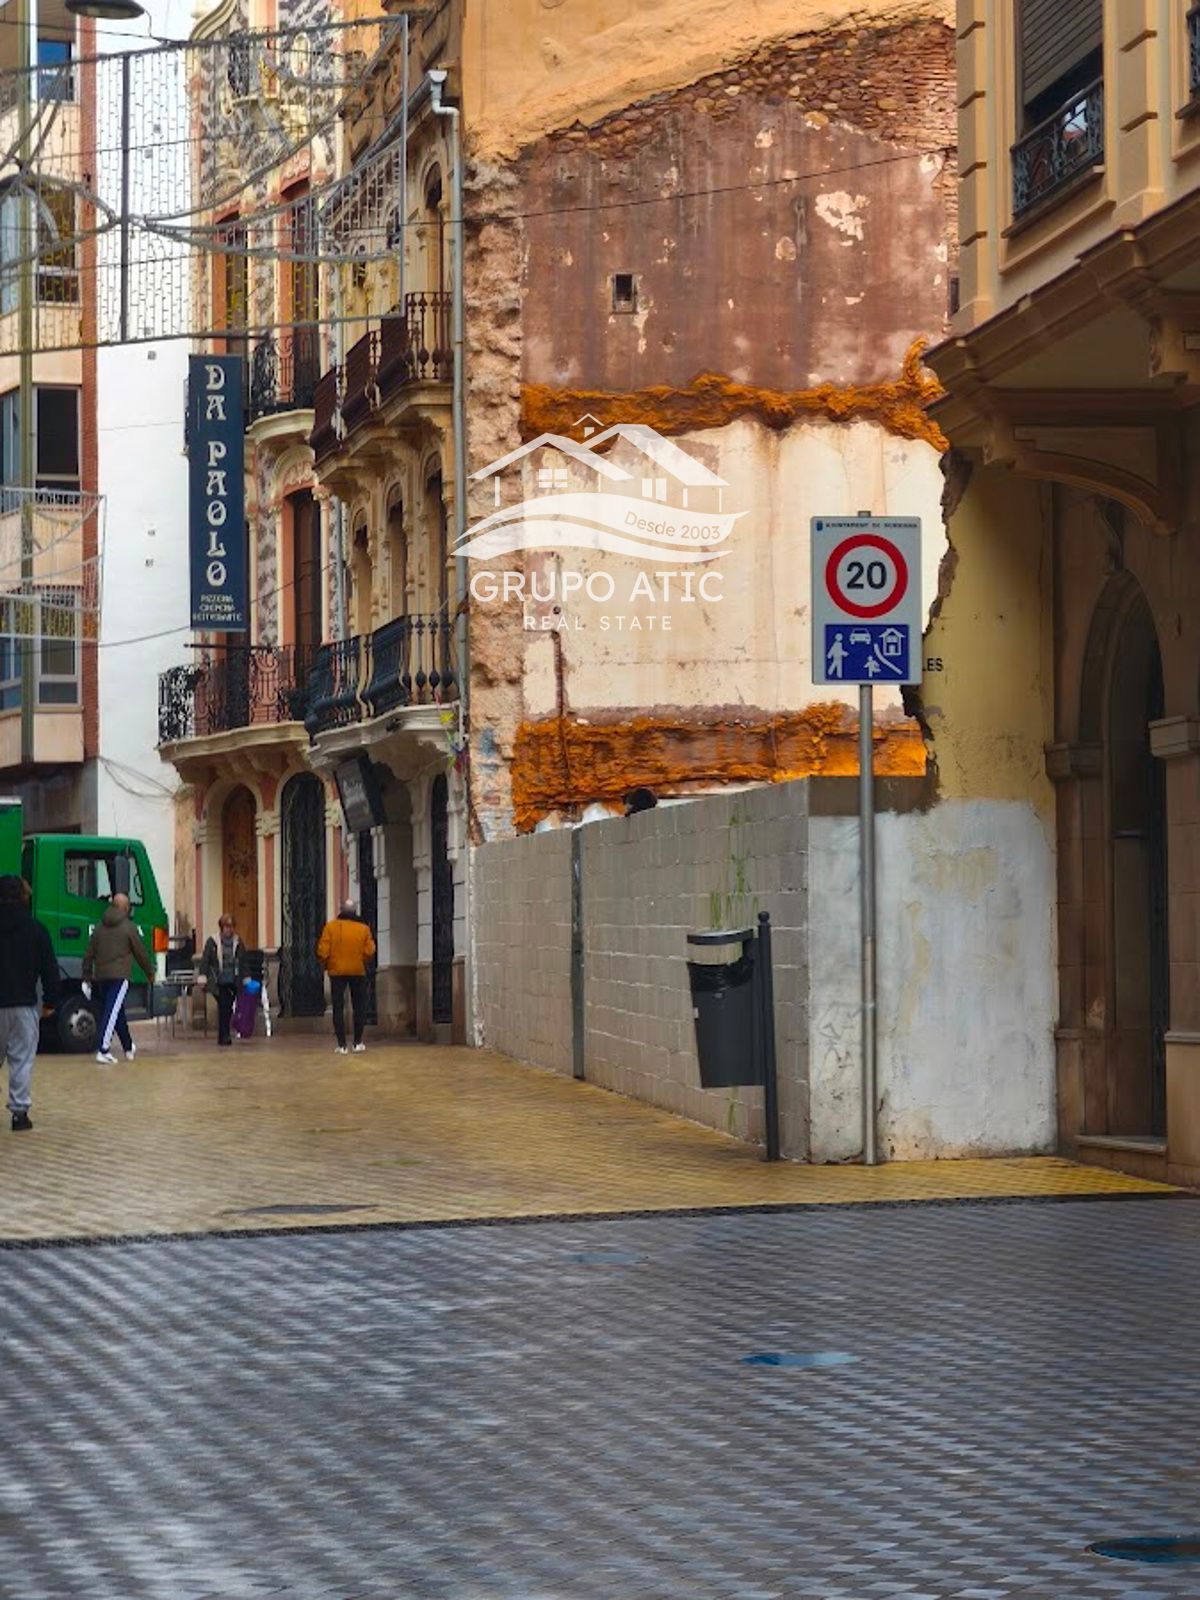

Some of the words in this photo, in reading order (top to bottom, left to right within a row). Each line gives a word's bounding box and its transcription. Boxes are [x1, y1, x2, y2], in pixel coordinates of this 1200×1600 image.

[204, 364, 227, 421] DA
[206, 440, 228, 587] PAOLO
[846, 560, 887, 590] 20
